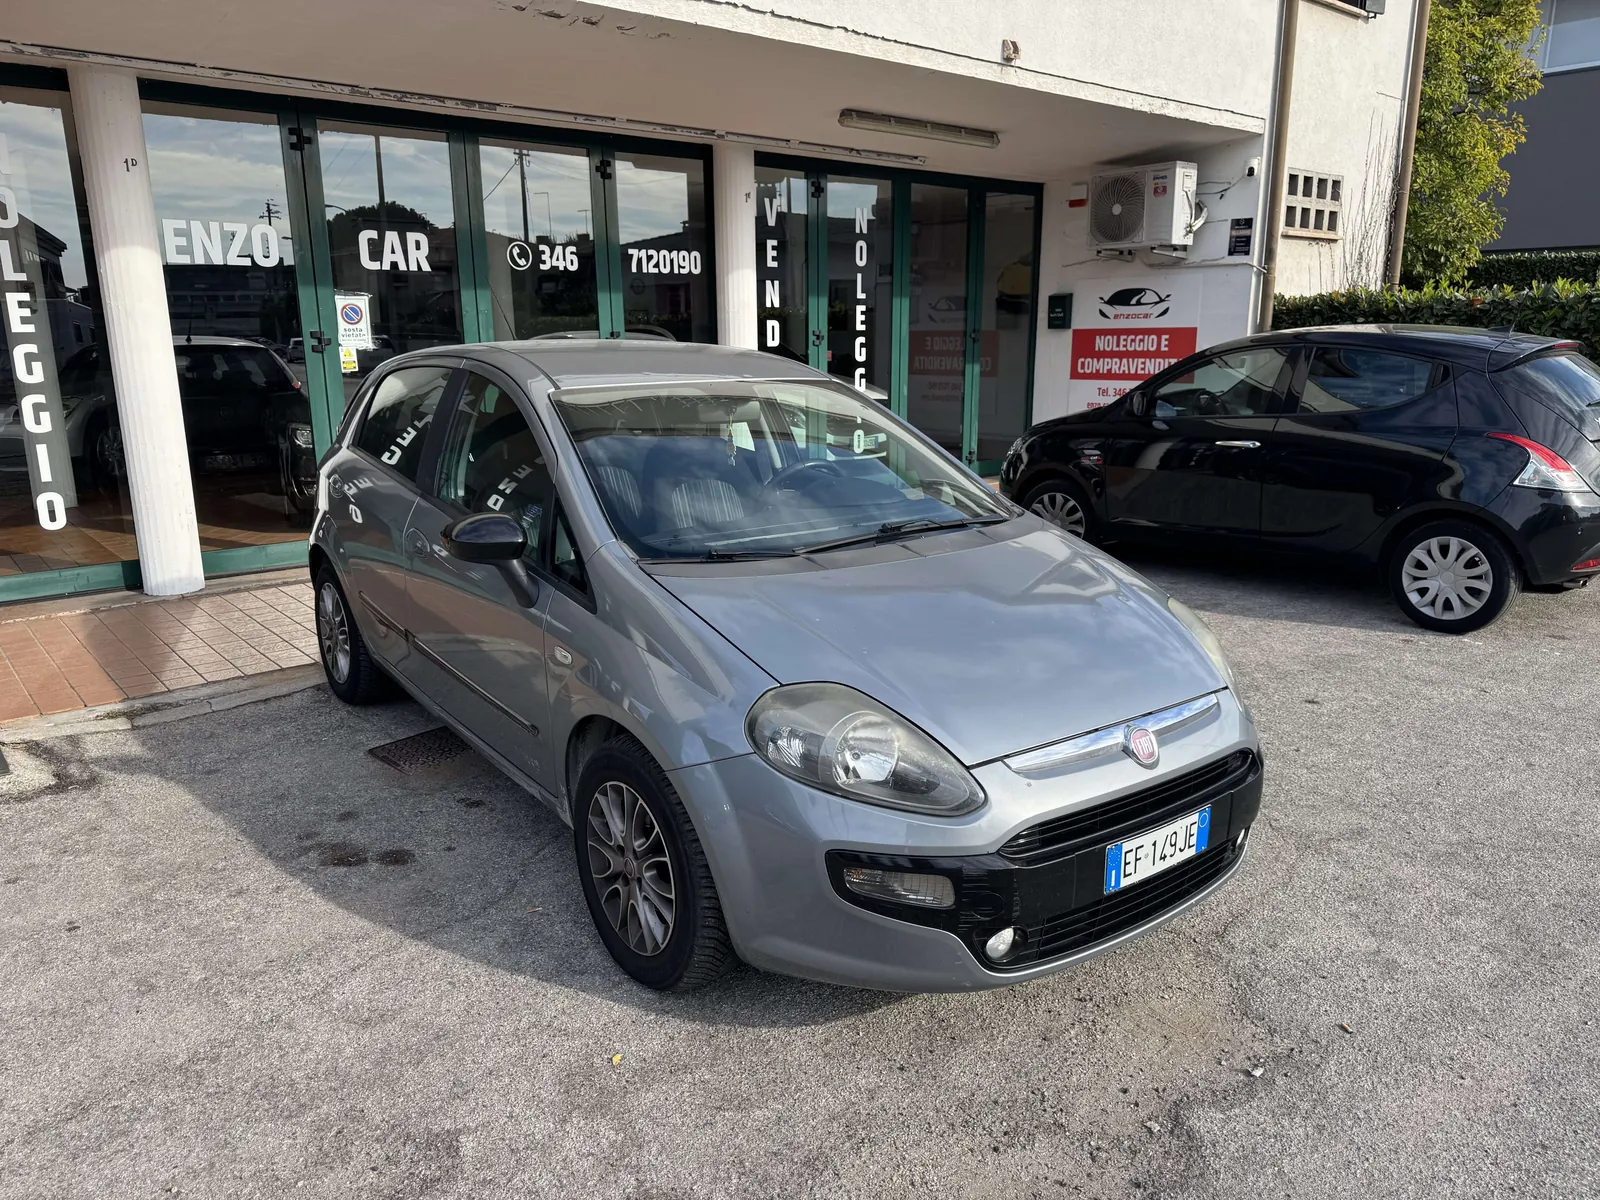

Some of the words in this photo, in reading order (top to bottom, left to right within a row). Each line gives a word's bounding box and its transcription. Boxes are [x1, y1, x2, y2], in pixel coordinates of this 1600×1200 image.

[123, 157, 138, 172] 1D
[161, 217, 280, 268] ENZO
[357, 229, 432, 272] CAR
[538, 244, 579, 272] 346
[627, 248, 702, 275] 7120190
[764, 197, 780, 348] VEND
[1113, 312, 1154, 320] enzocar
[1095, 335, 1158, 352] NOLEGGIO
[1161, 335, 1170, 351] E
[1077, 357, 1183, 375] COMPRAVENDIT
[1097, 386, 1111, 398] Tel.
[1112, 387, 1127, 398] 346
[1135, 735, 1154, 756] FIAT
